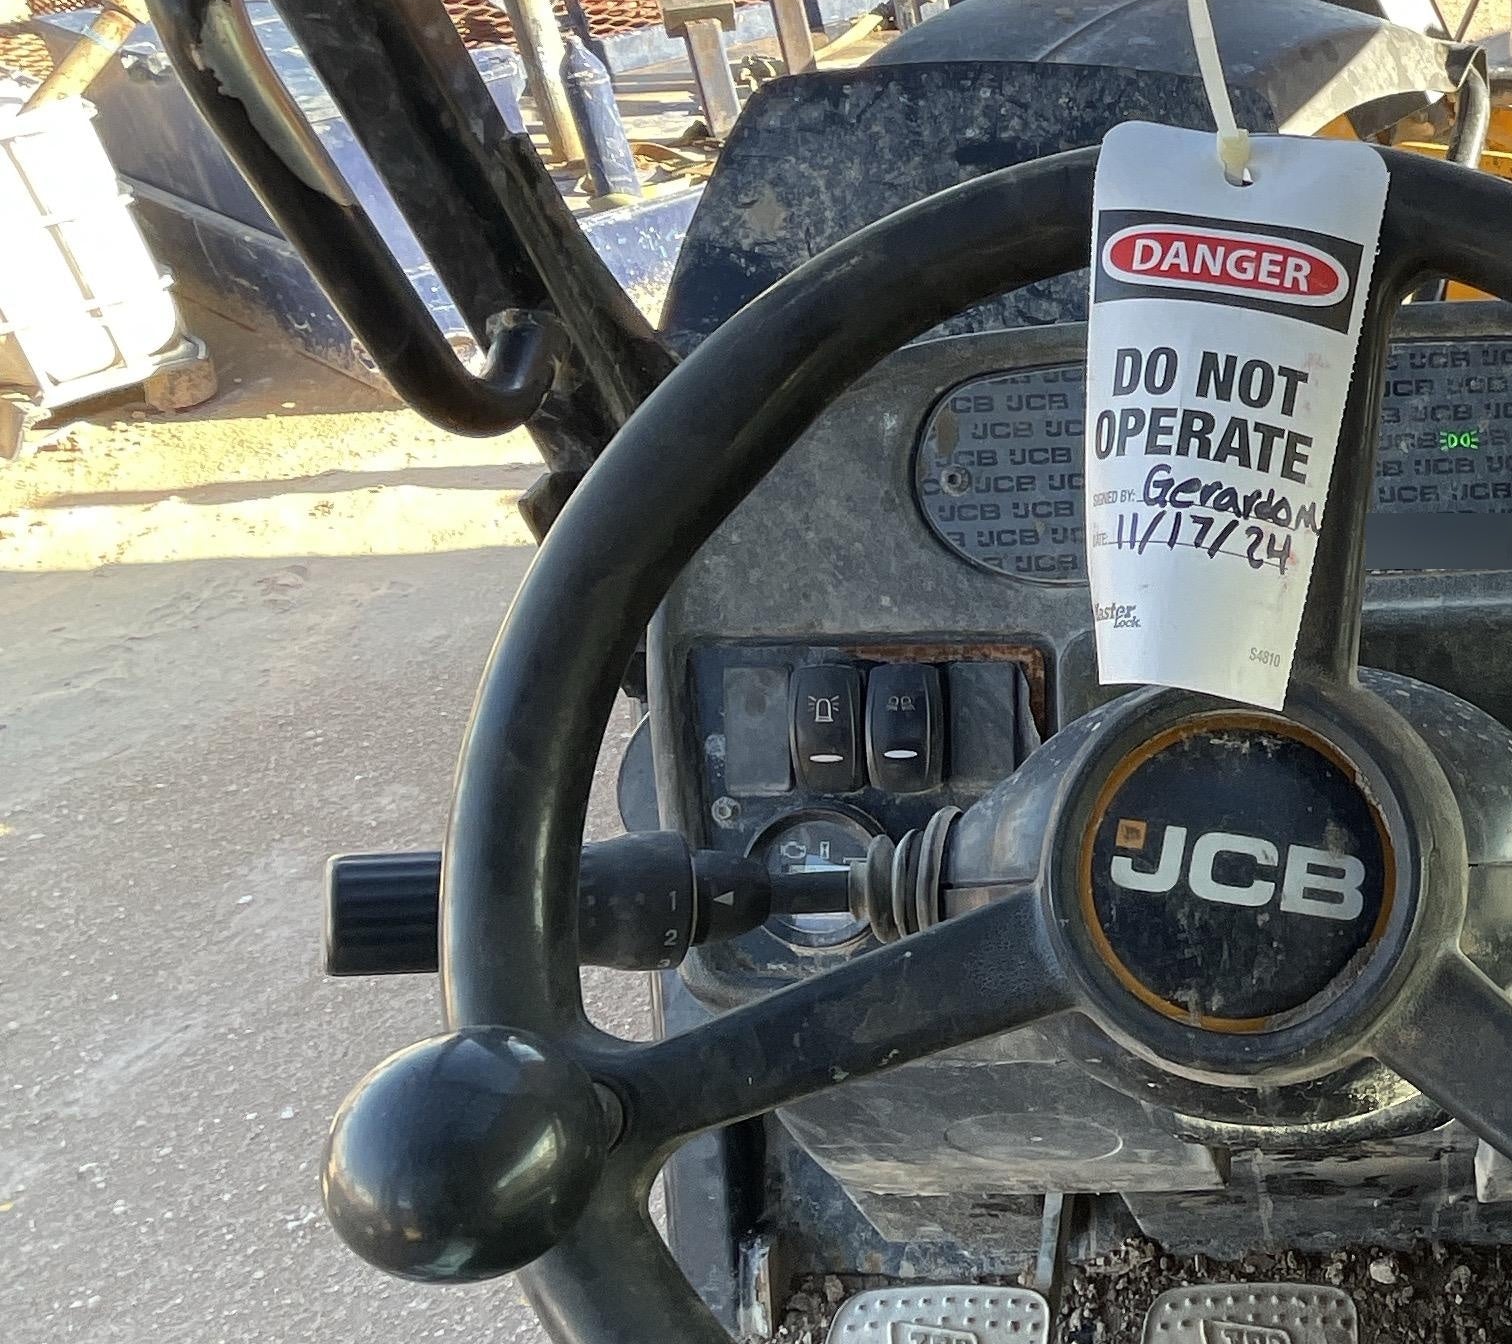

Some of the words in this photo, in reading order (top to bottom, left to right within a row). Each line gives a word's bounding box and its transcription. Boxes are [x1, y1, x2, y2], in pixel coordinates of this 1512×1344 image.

[1132, 238, 1312, 292] DANGER
[1112, 347, 1179, 397] DO
[1196, 351, 1309, 417] NOT
[950, 396, 994, 413] CB
[1007, 393, 1069, 411] JCB
[971, 422, 1034, 440] JCB
[1009, 447, 1071, 465] JCB
[1095, 408, 1313, 485] OPERATE
[975, 475, 1036, 494] JCB
[1120, 488, 1136, 503] BY:
[1012, 500, 1075, 519] JCB
[976, 529, 1040, 547] JCB
[1117, 510, 1292, 575] 11/17/24
[1015, 554, 1078, 572] JCB
[1249, 647, 1281, 668] S4810
[1111, 818, 1366, 921] JCB
[669, 890, 678, 912] 1
[663, 929, 679, 946] 2
